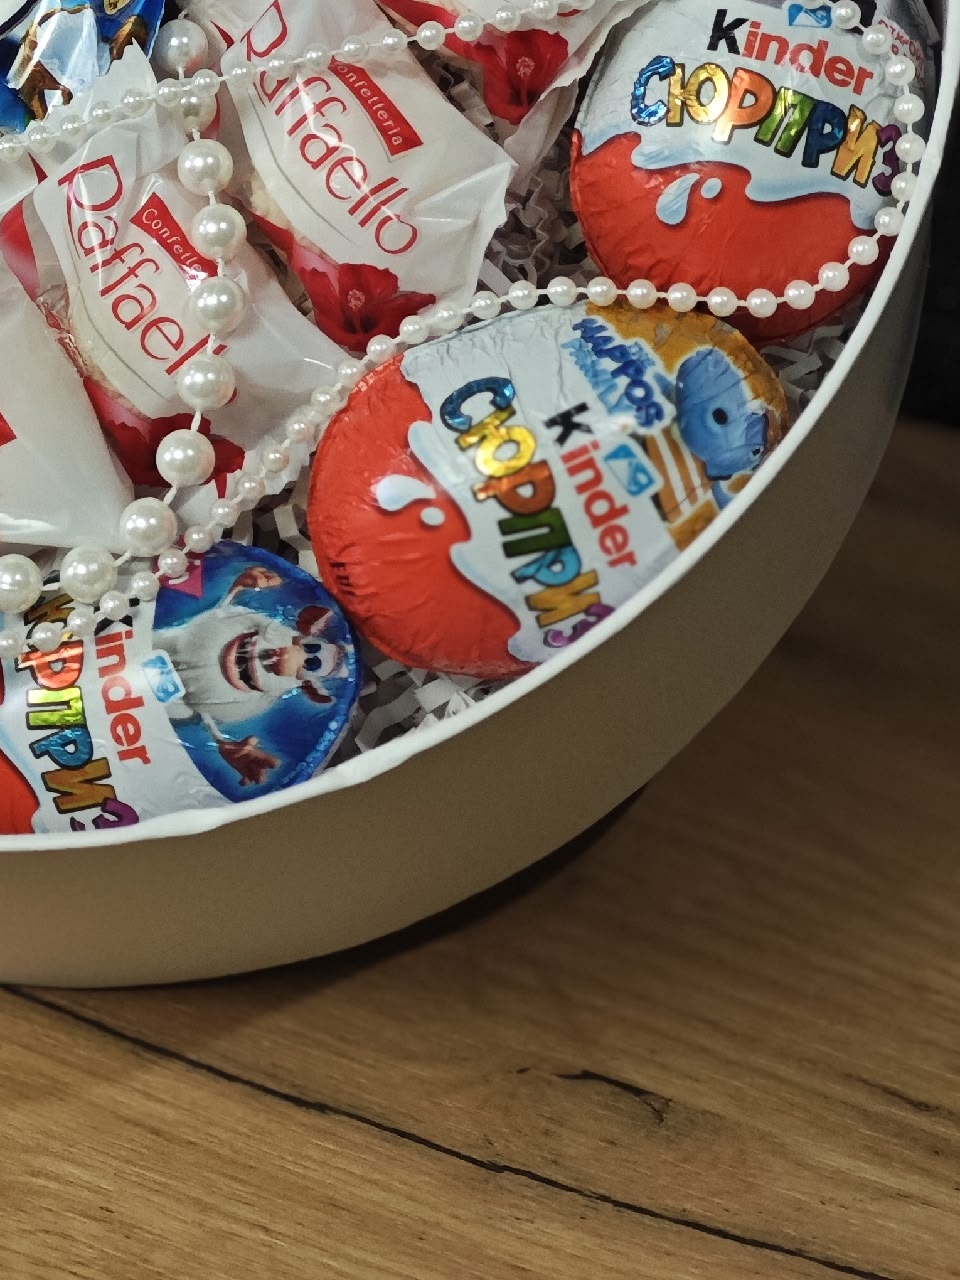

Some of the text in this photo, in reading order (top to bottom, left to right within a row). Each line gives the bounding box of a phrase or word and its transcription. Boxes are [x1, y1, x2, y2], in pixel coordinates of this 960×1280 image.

[629, 53, 899, 196] СЮРПРИЗ
[706, 6, 874, 97] Kinder
[440, 375, 614, 649] СЮРПРИЗ
[543, 401, 639, 573] Kinder
